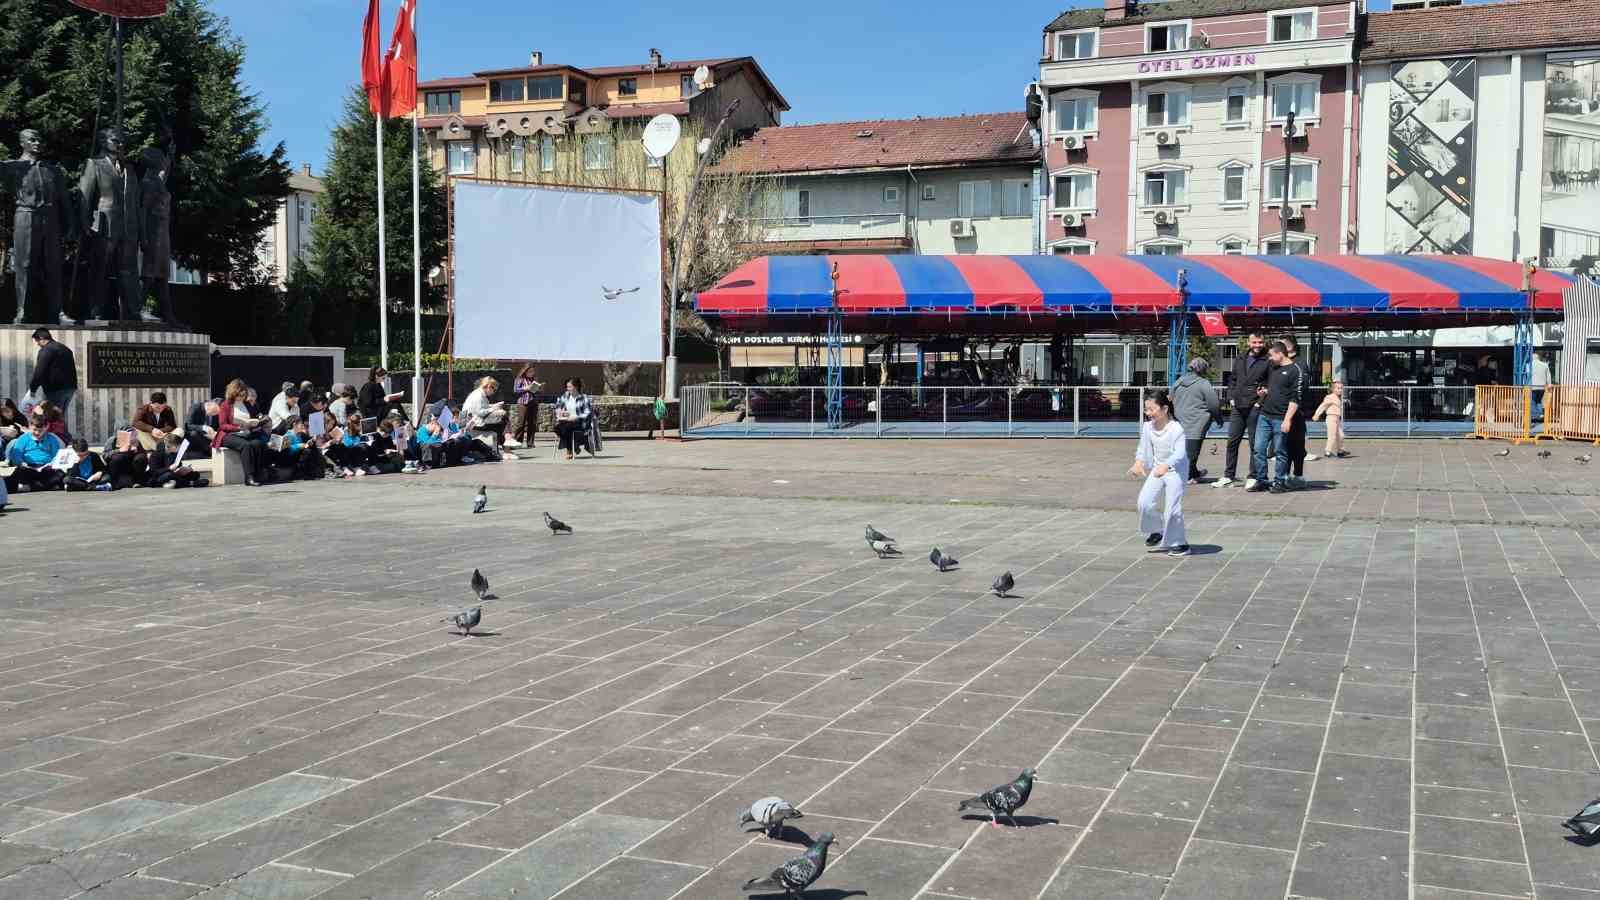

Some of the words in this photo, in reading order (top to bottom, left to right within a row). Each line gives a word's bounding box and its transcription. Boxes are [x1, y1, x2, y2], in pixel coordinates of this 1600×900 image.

[1138, 60, 1183, 73] OTEL
[1191, 54, 1257, 70] ÖZMEN
[744, 335, 784, 344] DOSTLAR
